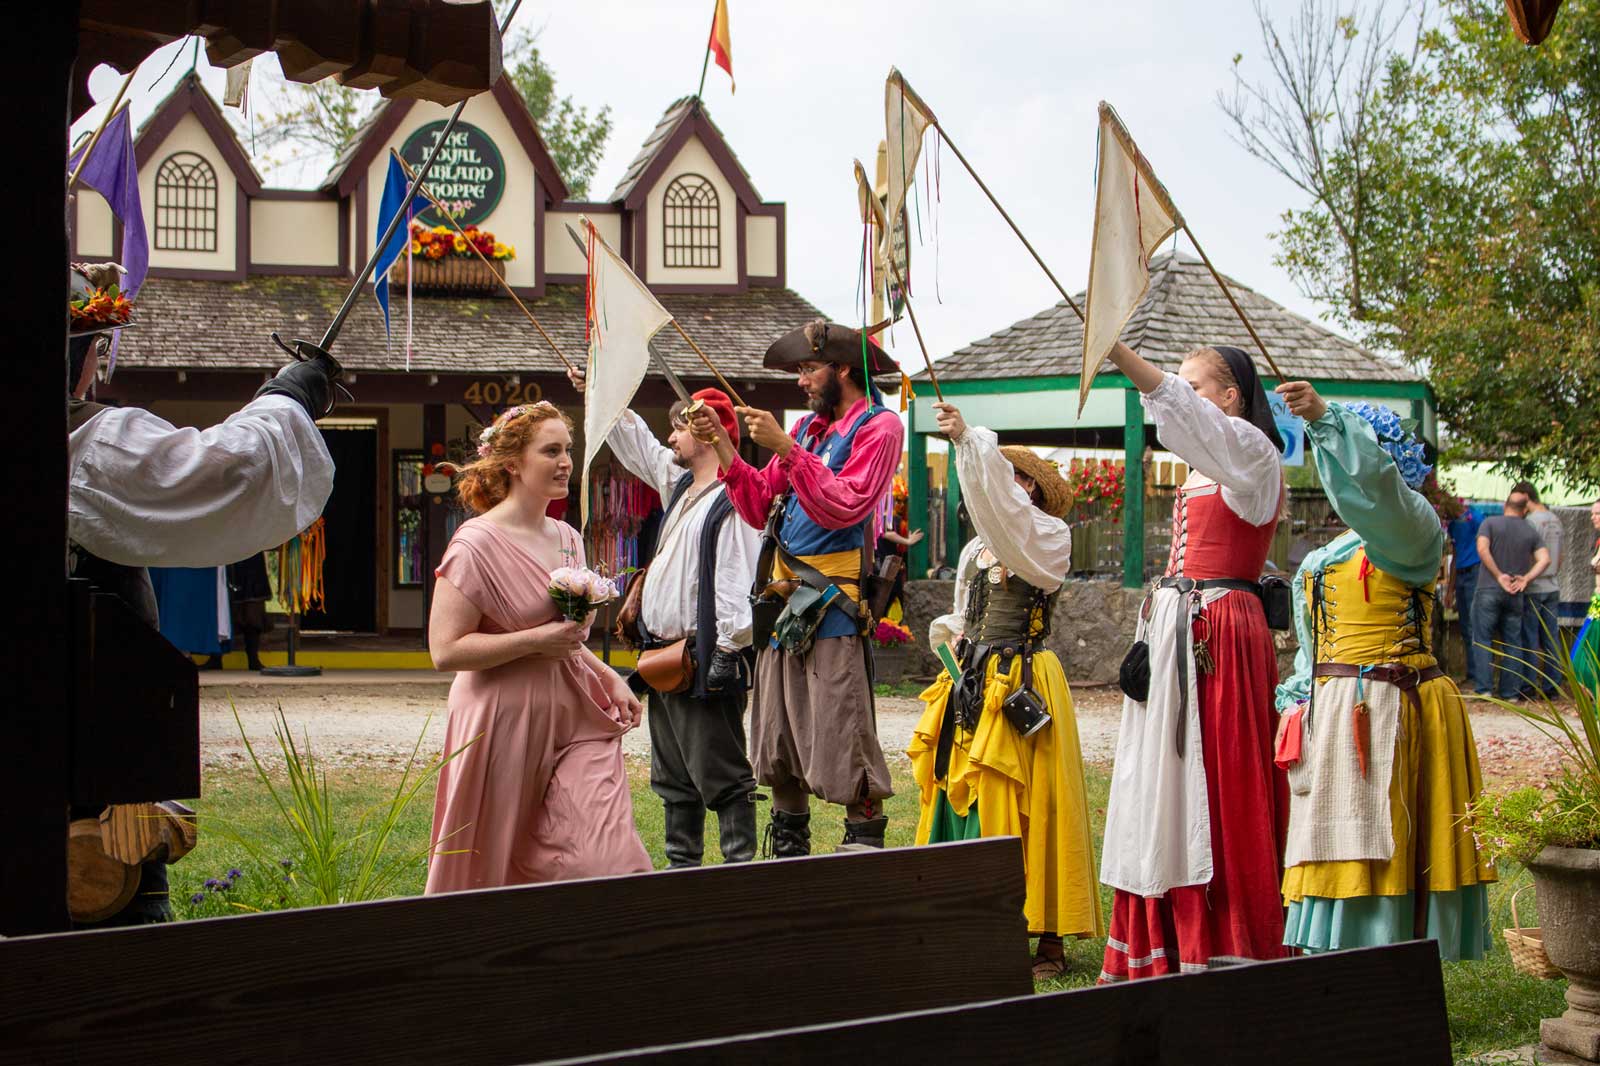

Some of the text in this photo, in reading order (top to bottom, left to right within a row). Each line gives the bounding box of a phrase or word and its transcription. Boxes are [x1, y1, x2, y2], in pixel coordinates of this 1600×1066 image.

[431, 130, 469, 148] THE
[421, 182, 487, 200] HOPPE
[463, 382, 542, 405] 4020
